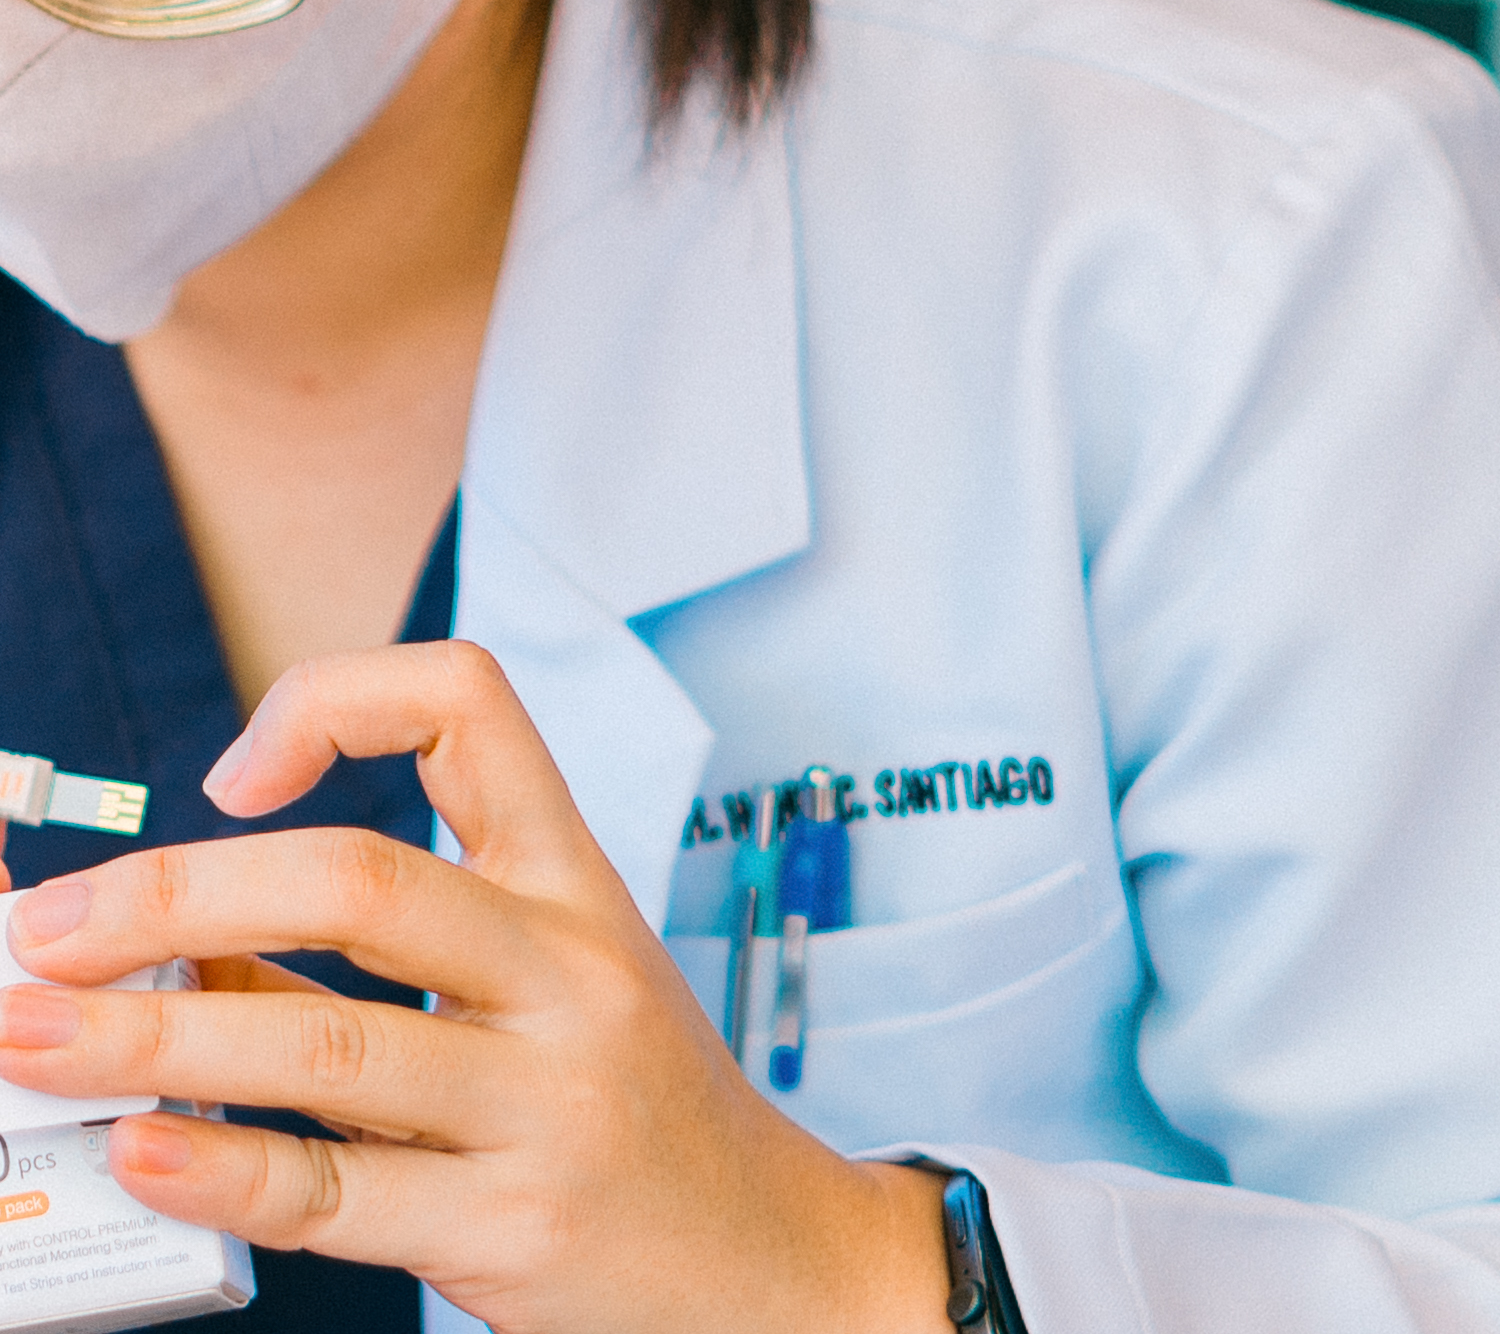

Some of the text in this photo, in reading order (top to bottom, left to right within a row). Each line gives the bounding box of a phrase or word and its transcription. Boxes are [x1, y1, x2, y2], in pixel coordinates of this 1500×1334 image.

[875, 756, 1055, 817] SANTIAGO
[18, 1152, 57, 1179] pcs
[5, 1196, 43, 1218] pack
[7, 1239, 31, 1253] with
[33, 1227, 95, 1248] CONTROL
[98, 1215, 158, 1235] PREMIUM
[51, 1241, 111, 1262] Monitoring
[3, 1280, 27, 1295] Test
[30, 1275, 63, 1292] Strips
[66, 1270, 88, 1283] and
[92, 1259, 150, 1278] Instruction
